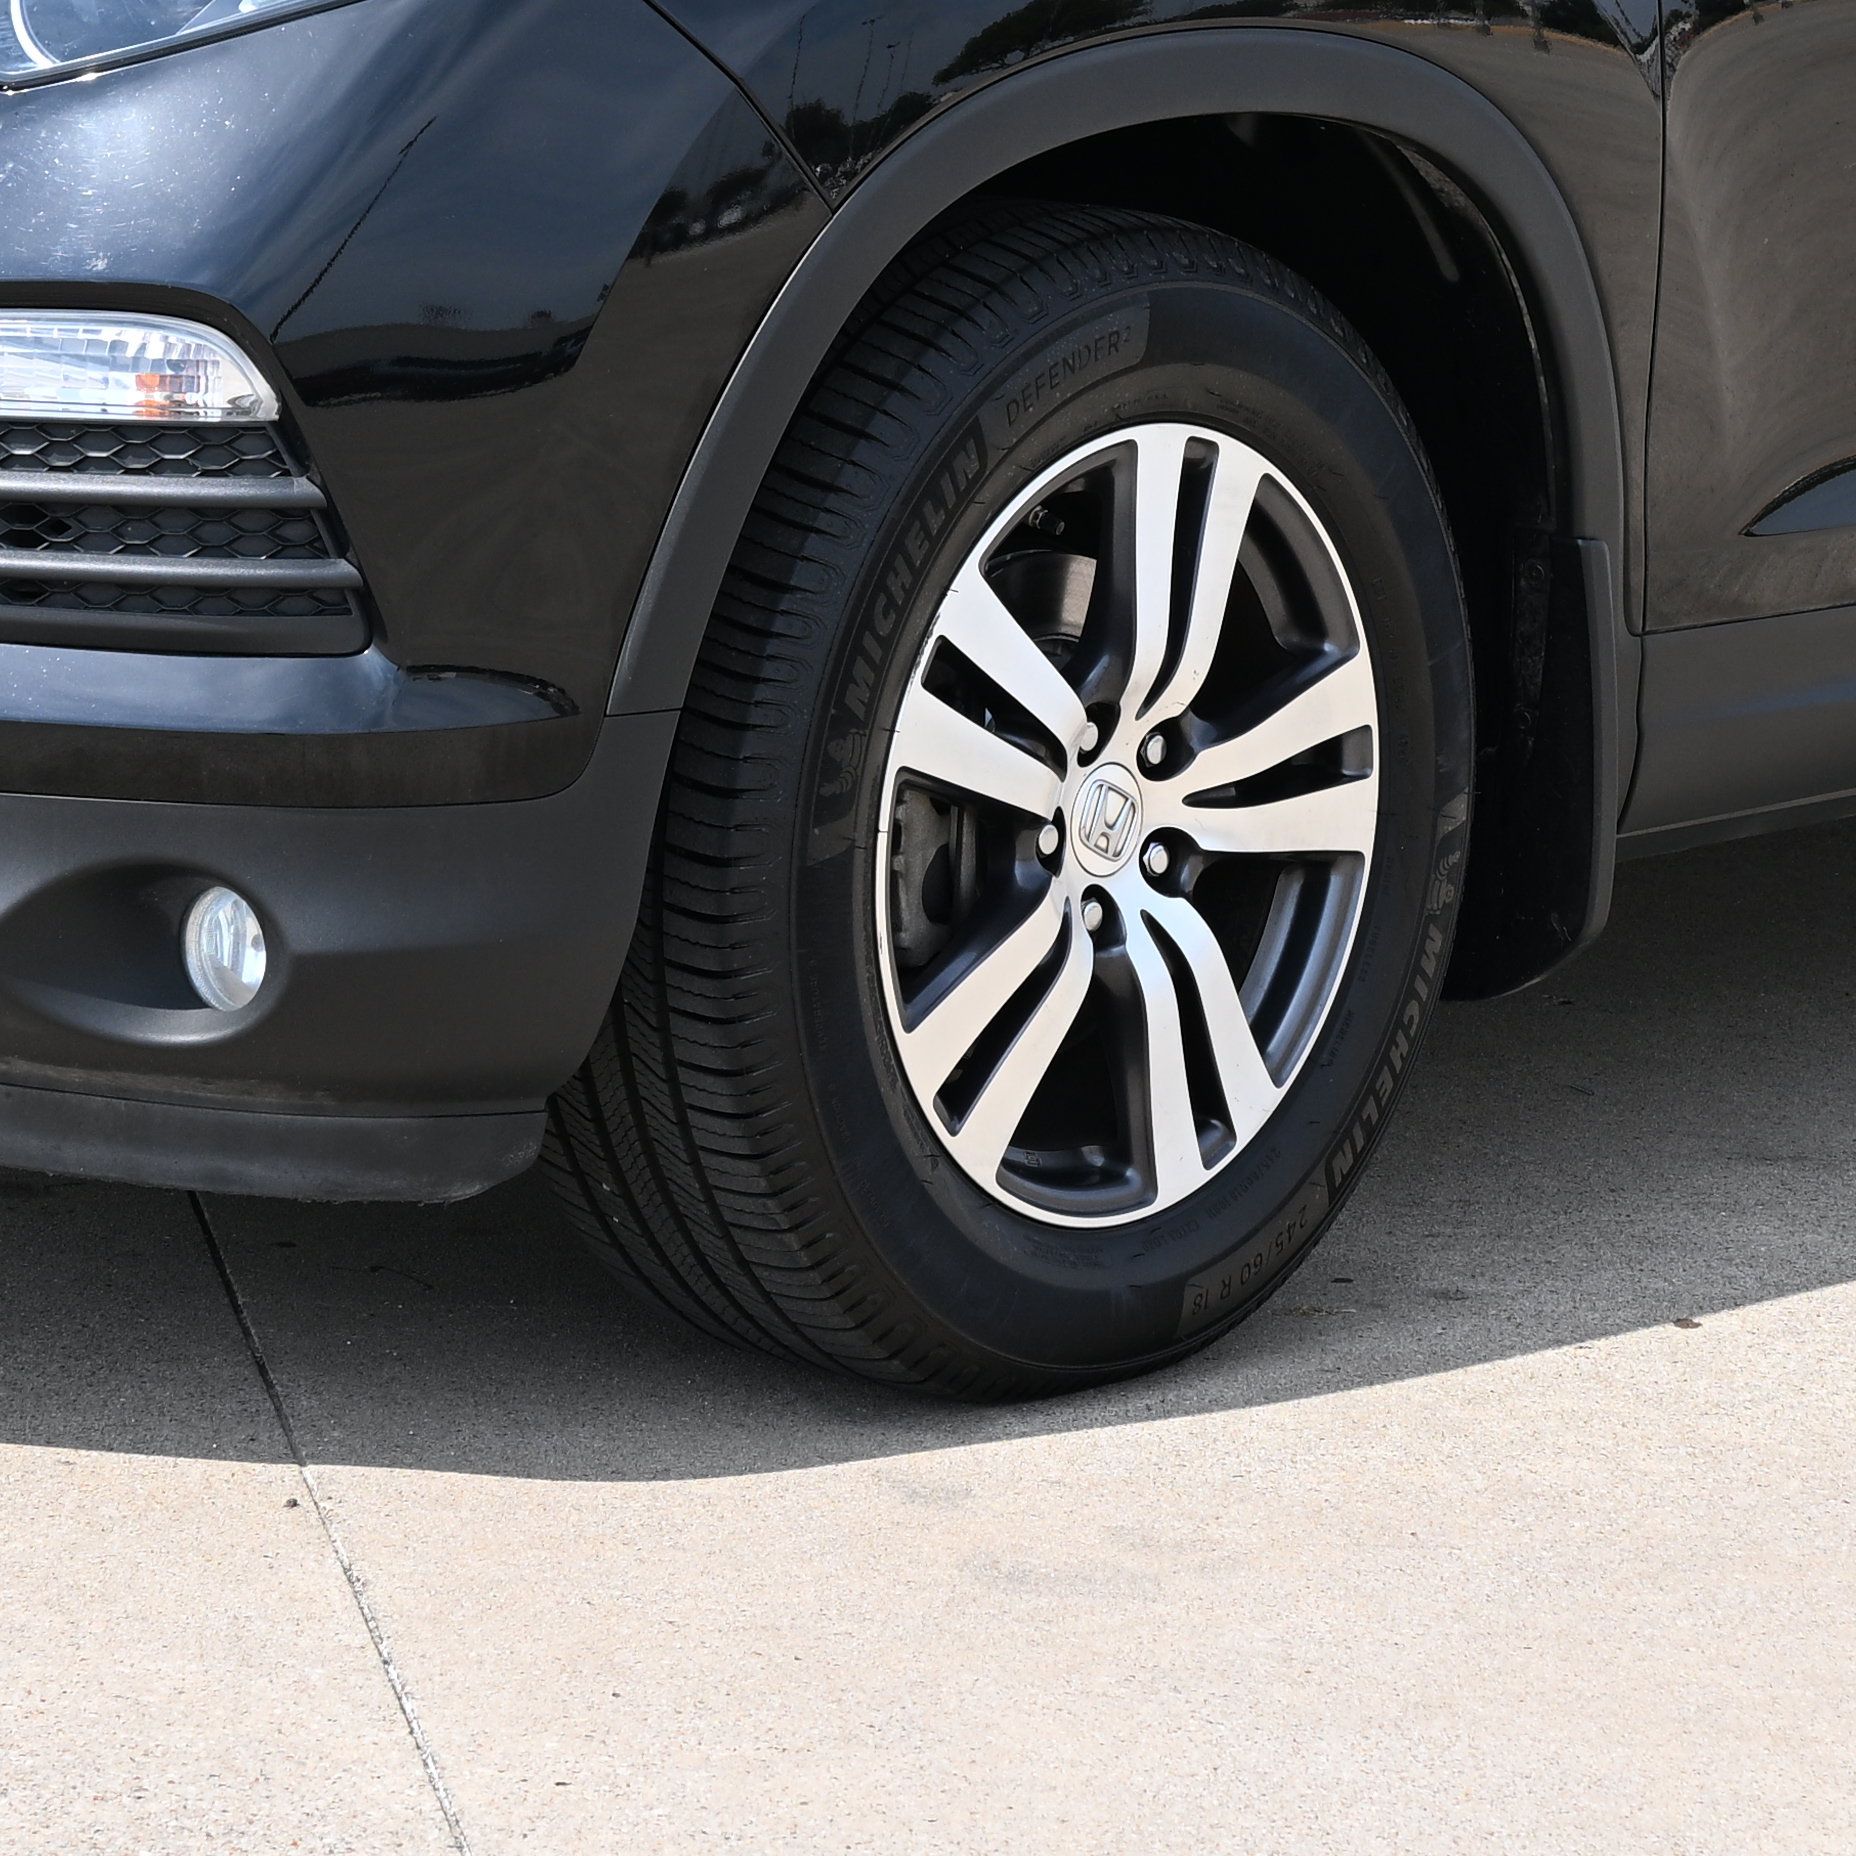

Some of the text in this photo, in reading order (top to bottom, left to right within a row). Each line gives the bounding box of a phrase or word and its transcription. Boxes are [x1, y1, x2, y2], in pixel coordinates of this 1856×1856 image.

[845, 439, 984, 721] MICHELIN
[1331, 922, 1446, 1189] MICHELIN
[1240, 1204, 1309, 1288] 245/60
[1191, 1287, 1211, 1316] 18
[1218, 1275, 1233, 1302] R
